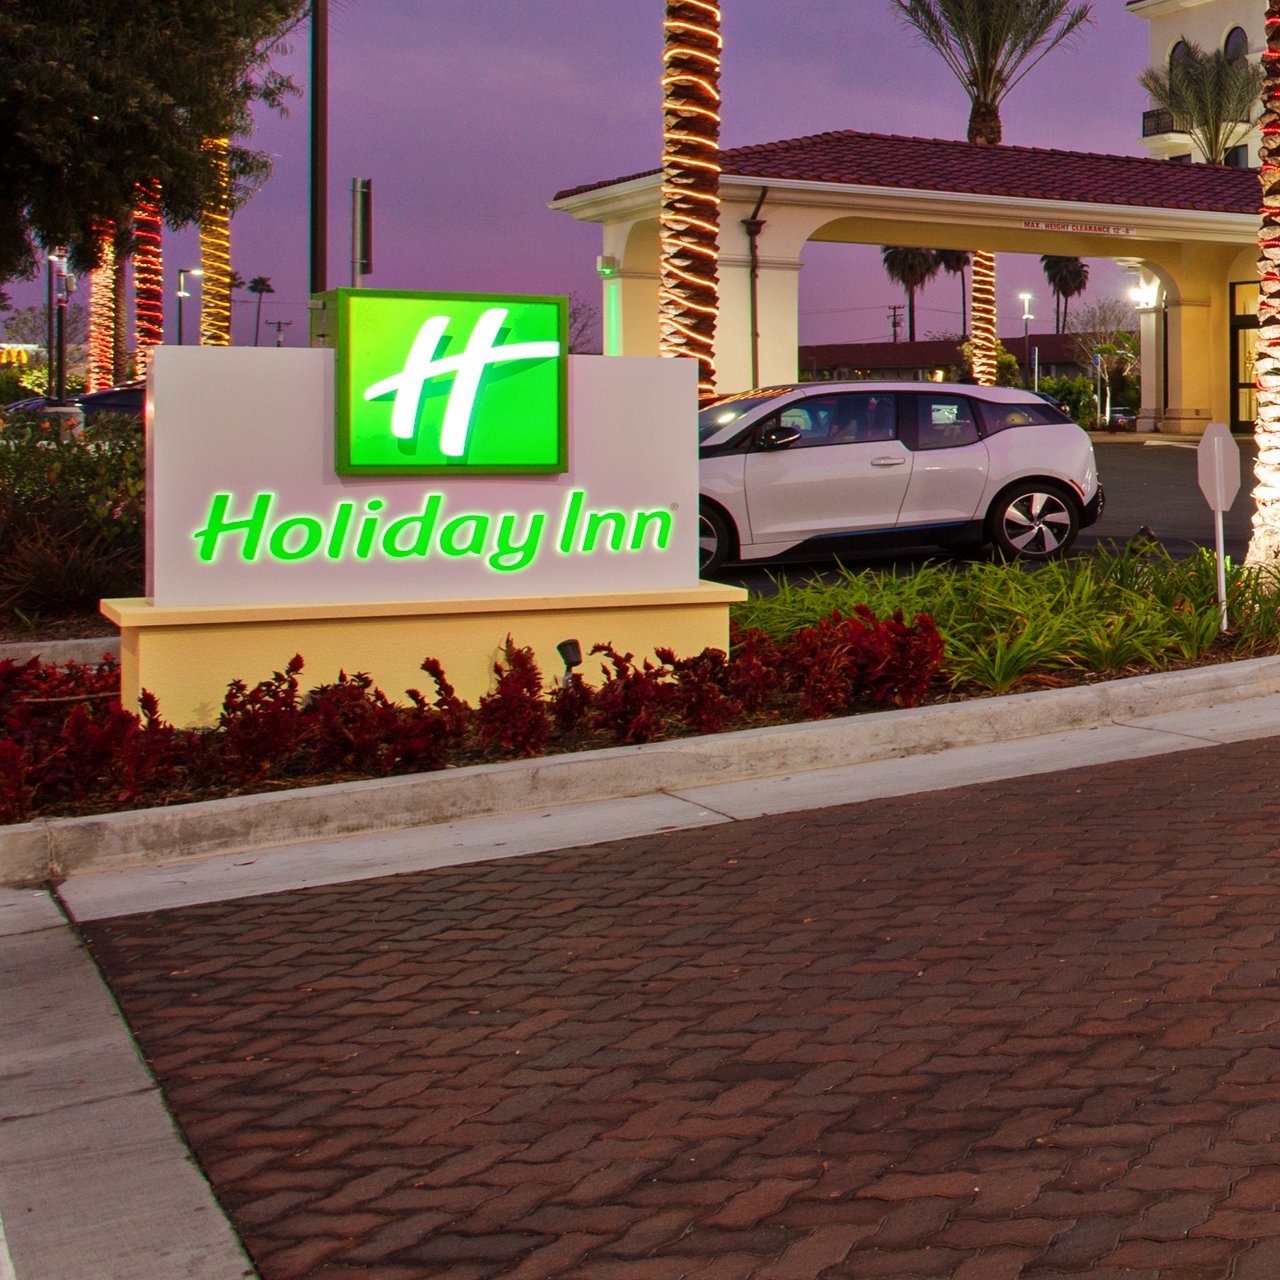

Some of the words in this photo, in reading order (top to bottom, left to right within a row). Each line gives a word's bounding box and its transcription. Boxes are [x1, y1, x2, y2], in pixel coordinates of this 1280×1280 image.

[1044, 223, 1069, 231] HEIGHT
[1071, 224, 1110, 233] CLEARANCE
[363, 308, 560, 457] H
[191, 491, 546, 573] Holiday
[558, 489, 674, 556] Inn
